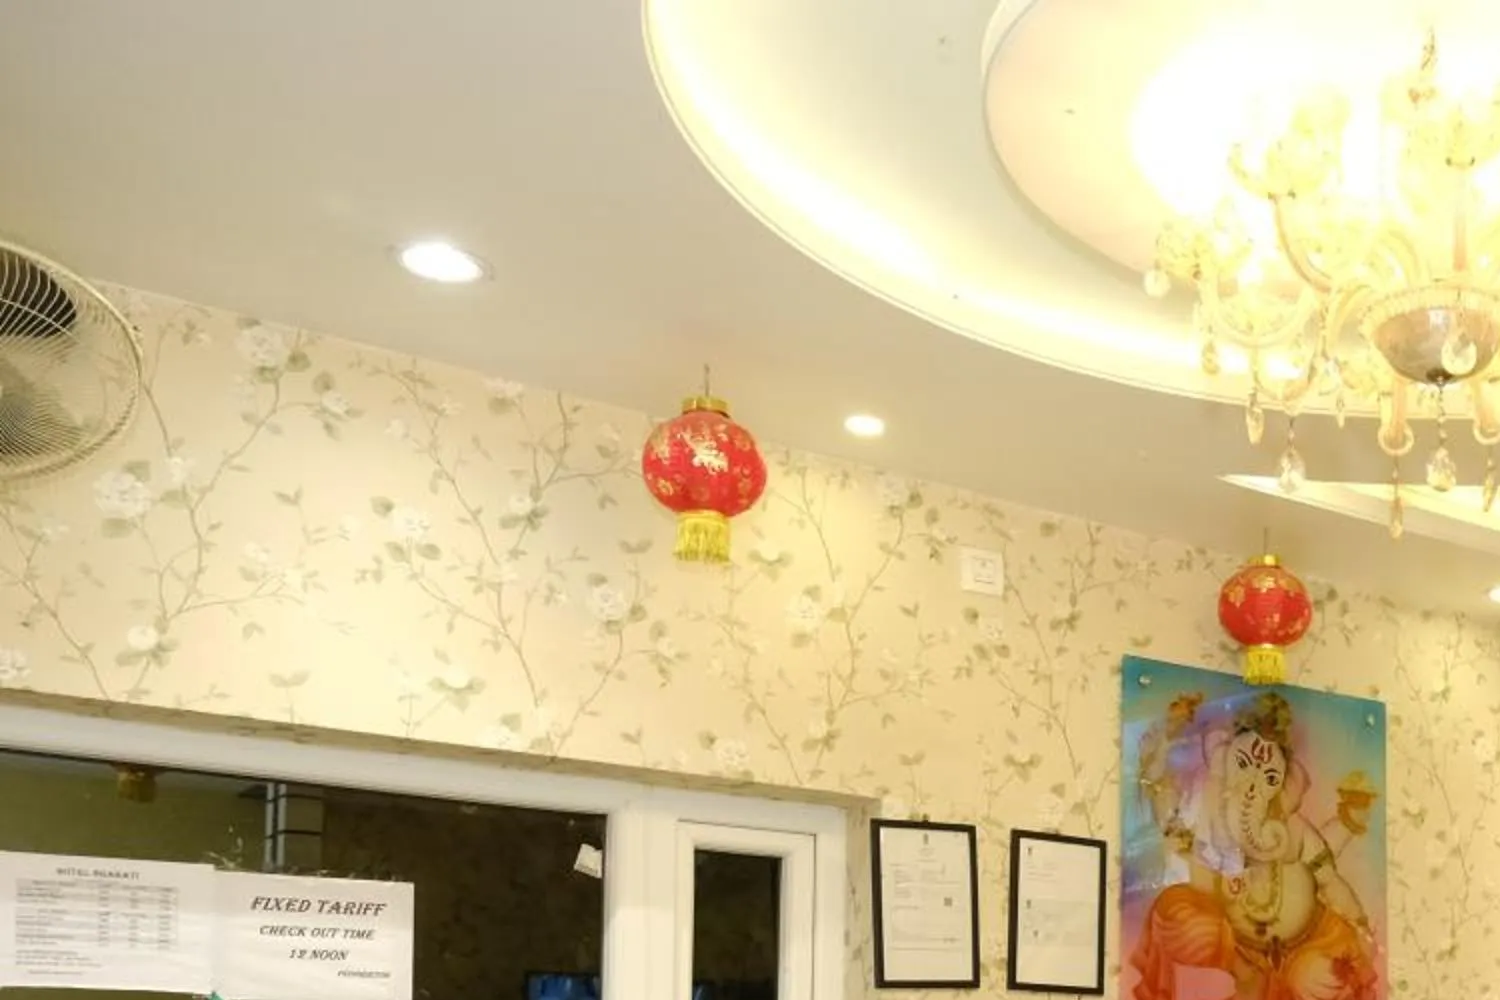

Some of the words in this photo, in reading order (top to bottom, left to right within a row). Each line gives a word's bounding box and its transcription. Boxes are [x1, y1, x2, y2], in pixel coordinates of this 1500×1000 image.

[250, 895, 311, 913] FIXED
[316, 899, 388, 917] TARIFF
[259, 925, 308, 939] CHECK
[310, 926, 340, 939] OUT
[343, 928, 376, 941] TIME
[289, 948, 307, 960] 12
[309, 949, 350, 961] NOON
